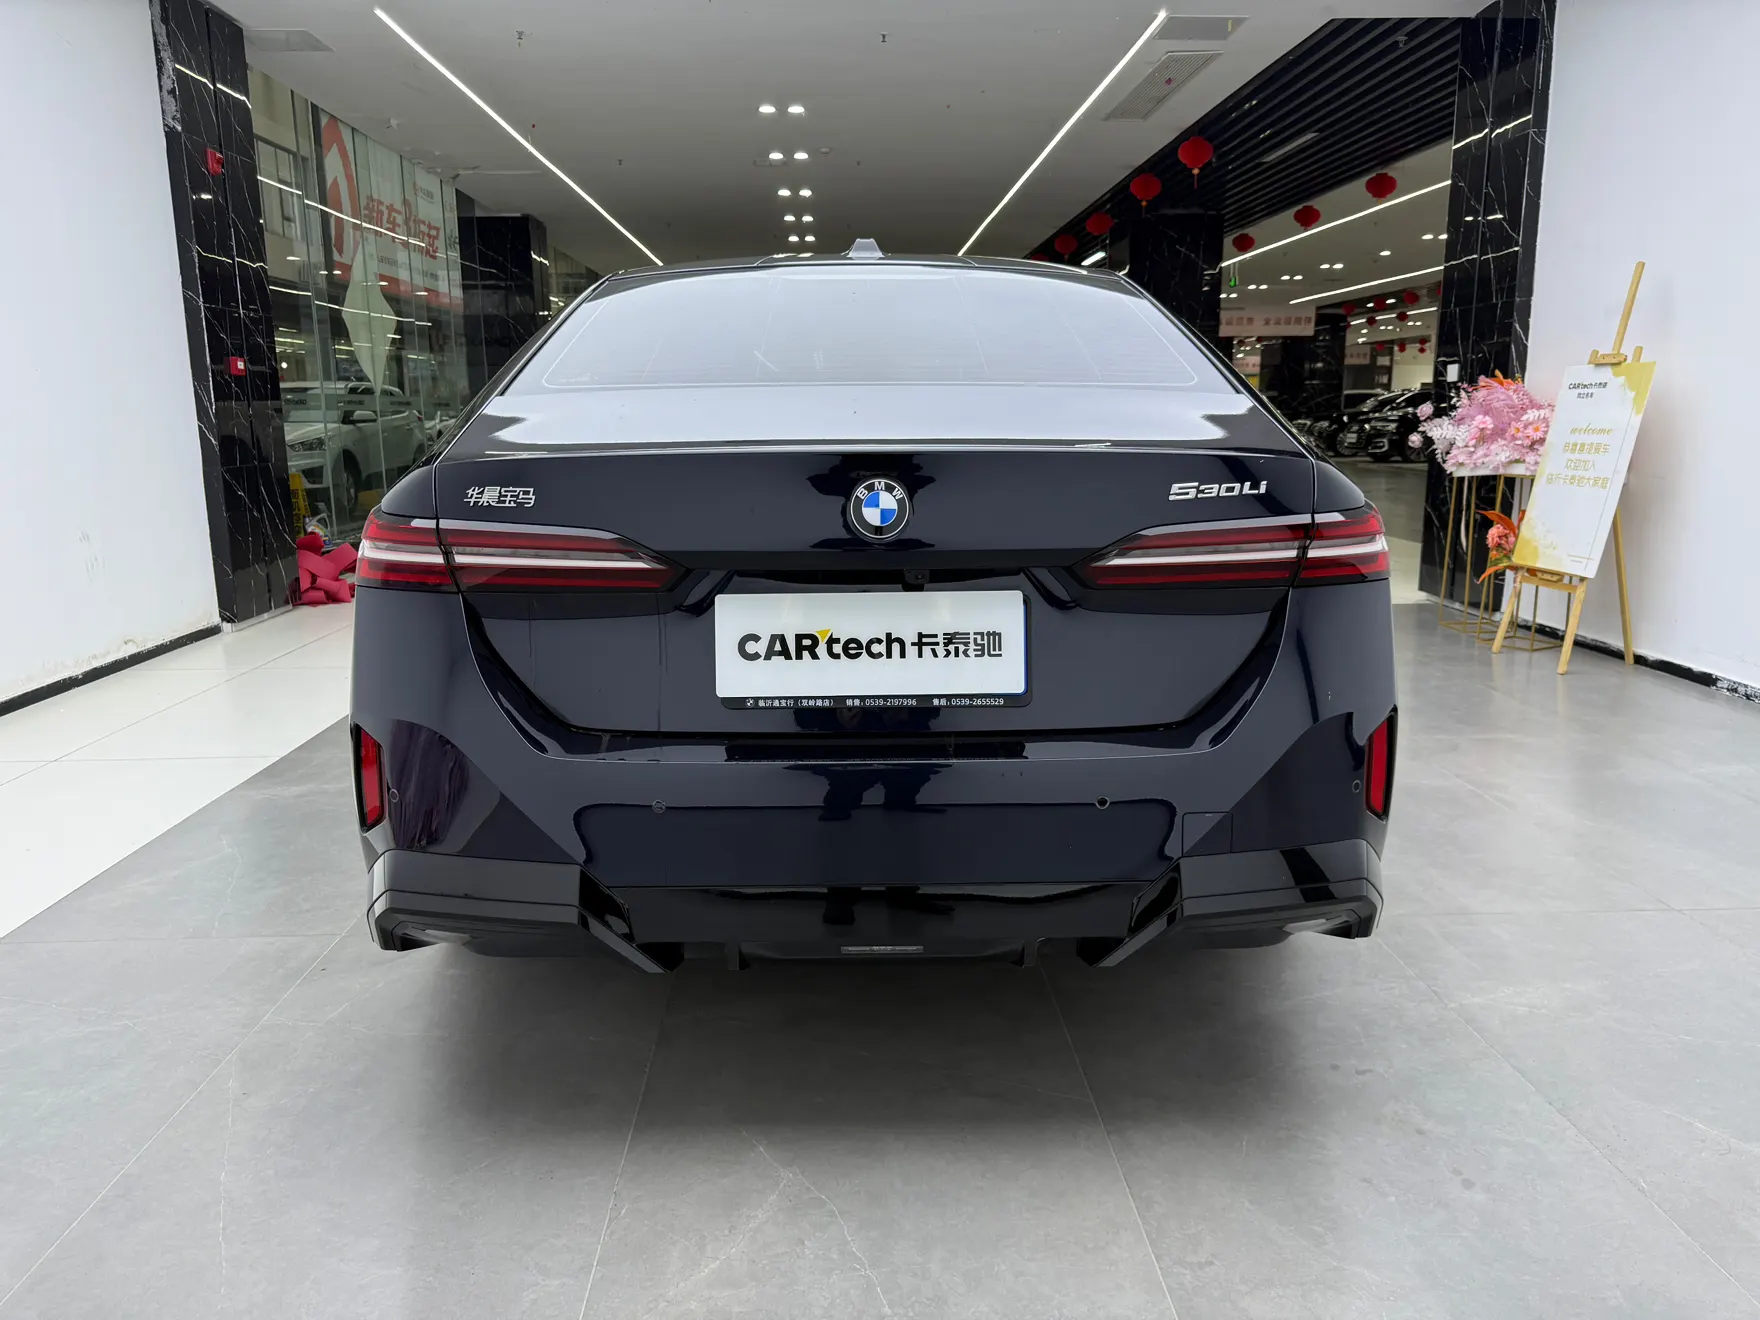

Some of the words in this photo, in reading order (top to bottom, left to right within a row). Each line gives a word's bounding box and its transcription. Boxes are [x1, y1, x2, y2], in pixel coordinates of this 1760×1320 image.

[1570, 422, 1613, 435] welcome
[1564, 458, 1596, 472] 欢迎加入
[463, 486, 536, 507] 华晨宝马
[857, 481, 904, 500] BMW
[1168, 481, 1268, 501] 530Li
[911, 631, 1003, 659] 卡泰驰
